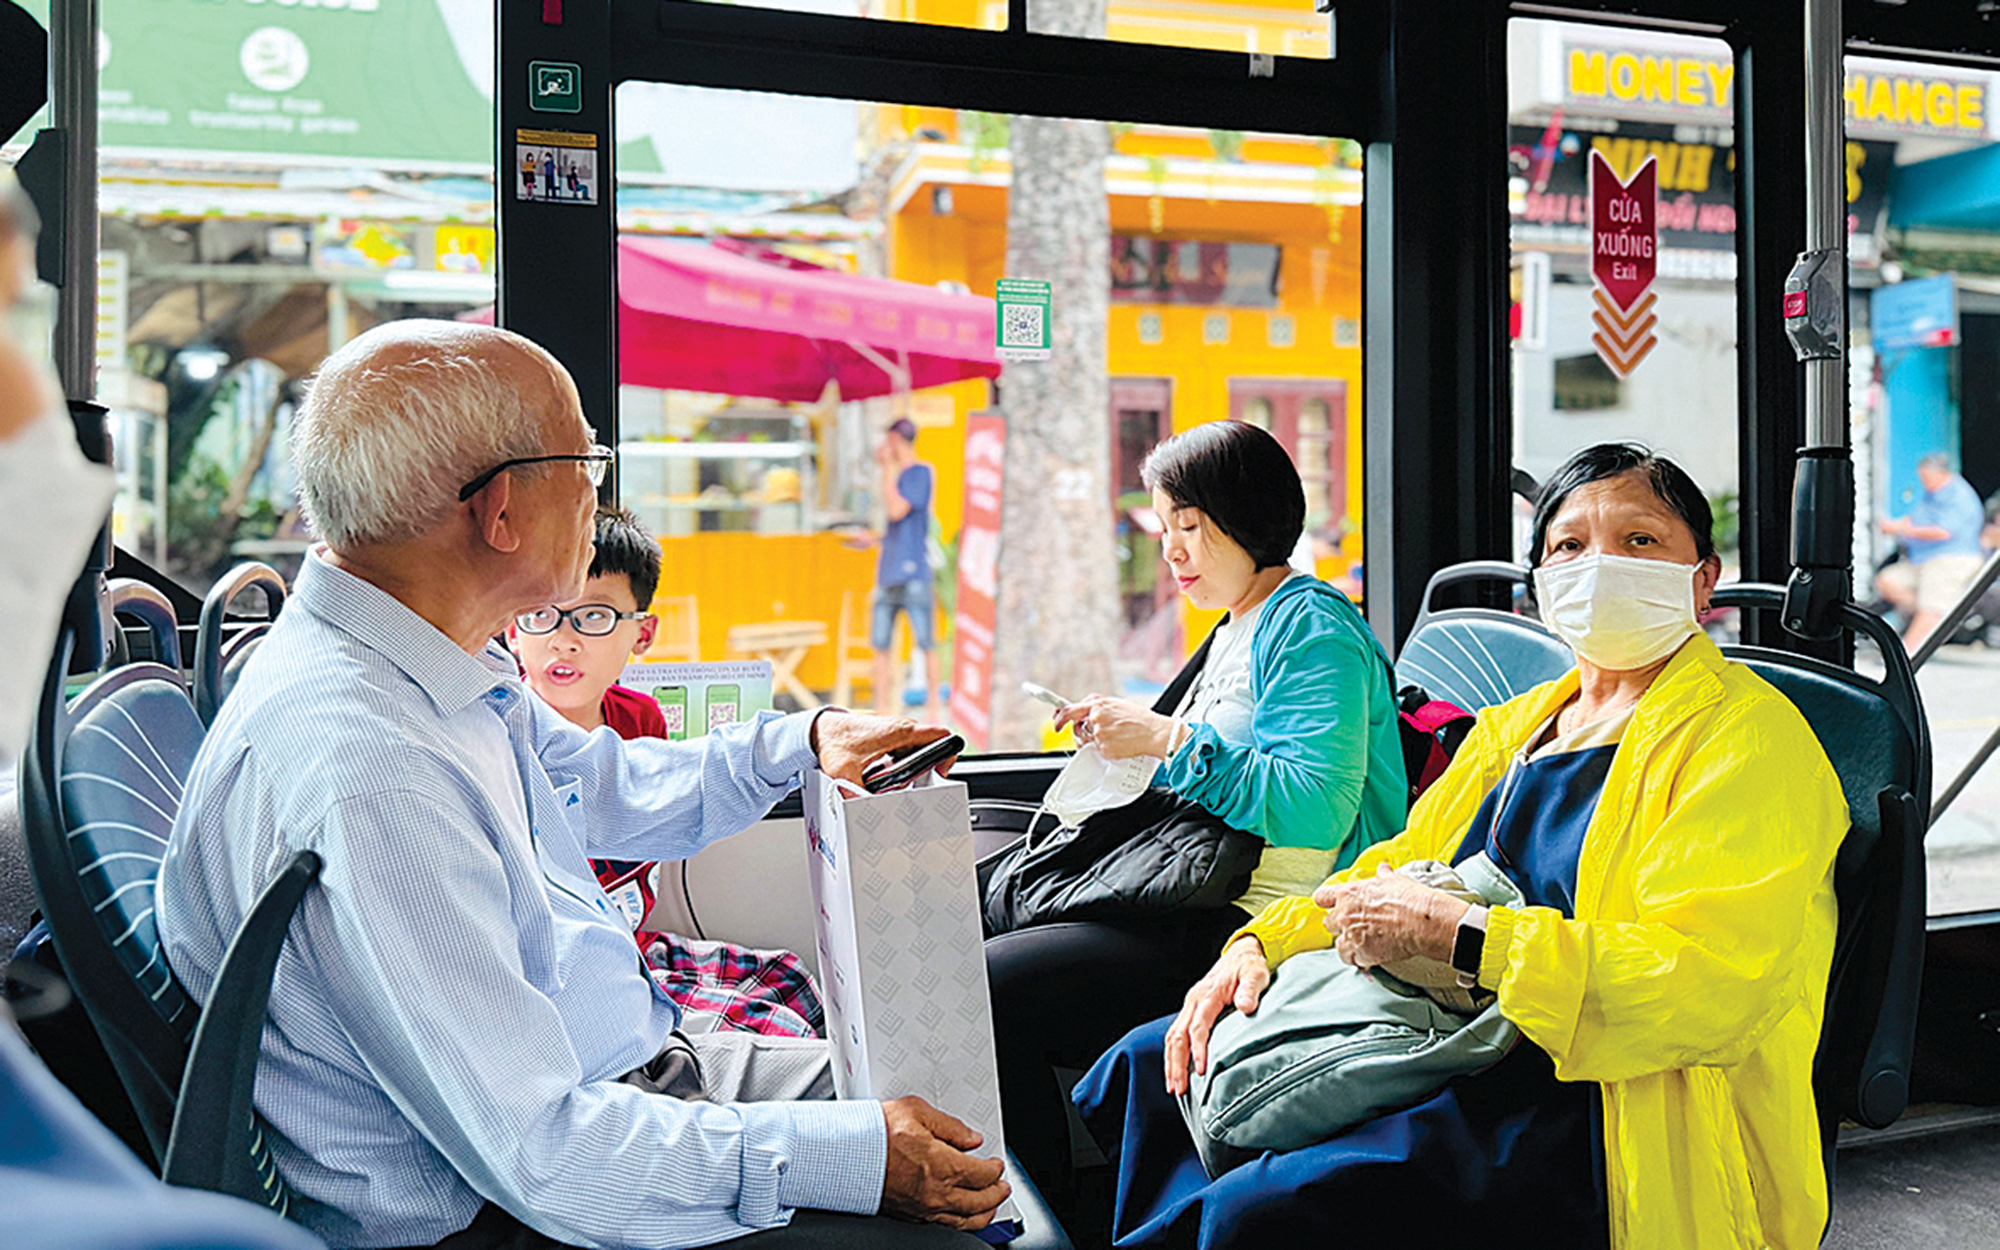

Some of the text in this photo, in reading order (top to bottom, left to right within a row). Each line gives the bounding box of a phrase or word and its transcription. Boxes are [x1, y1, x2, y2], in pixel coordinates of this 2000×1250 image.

[1571, 50, 1734, 106] MONEY
[1609, 192, 1643, 224] CỬA
[1597, 225, 1653, 259] XUỐNG
[1612, 261, 1638, 281] Exit
